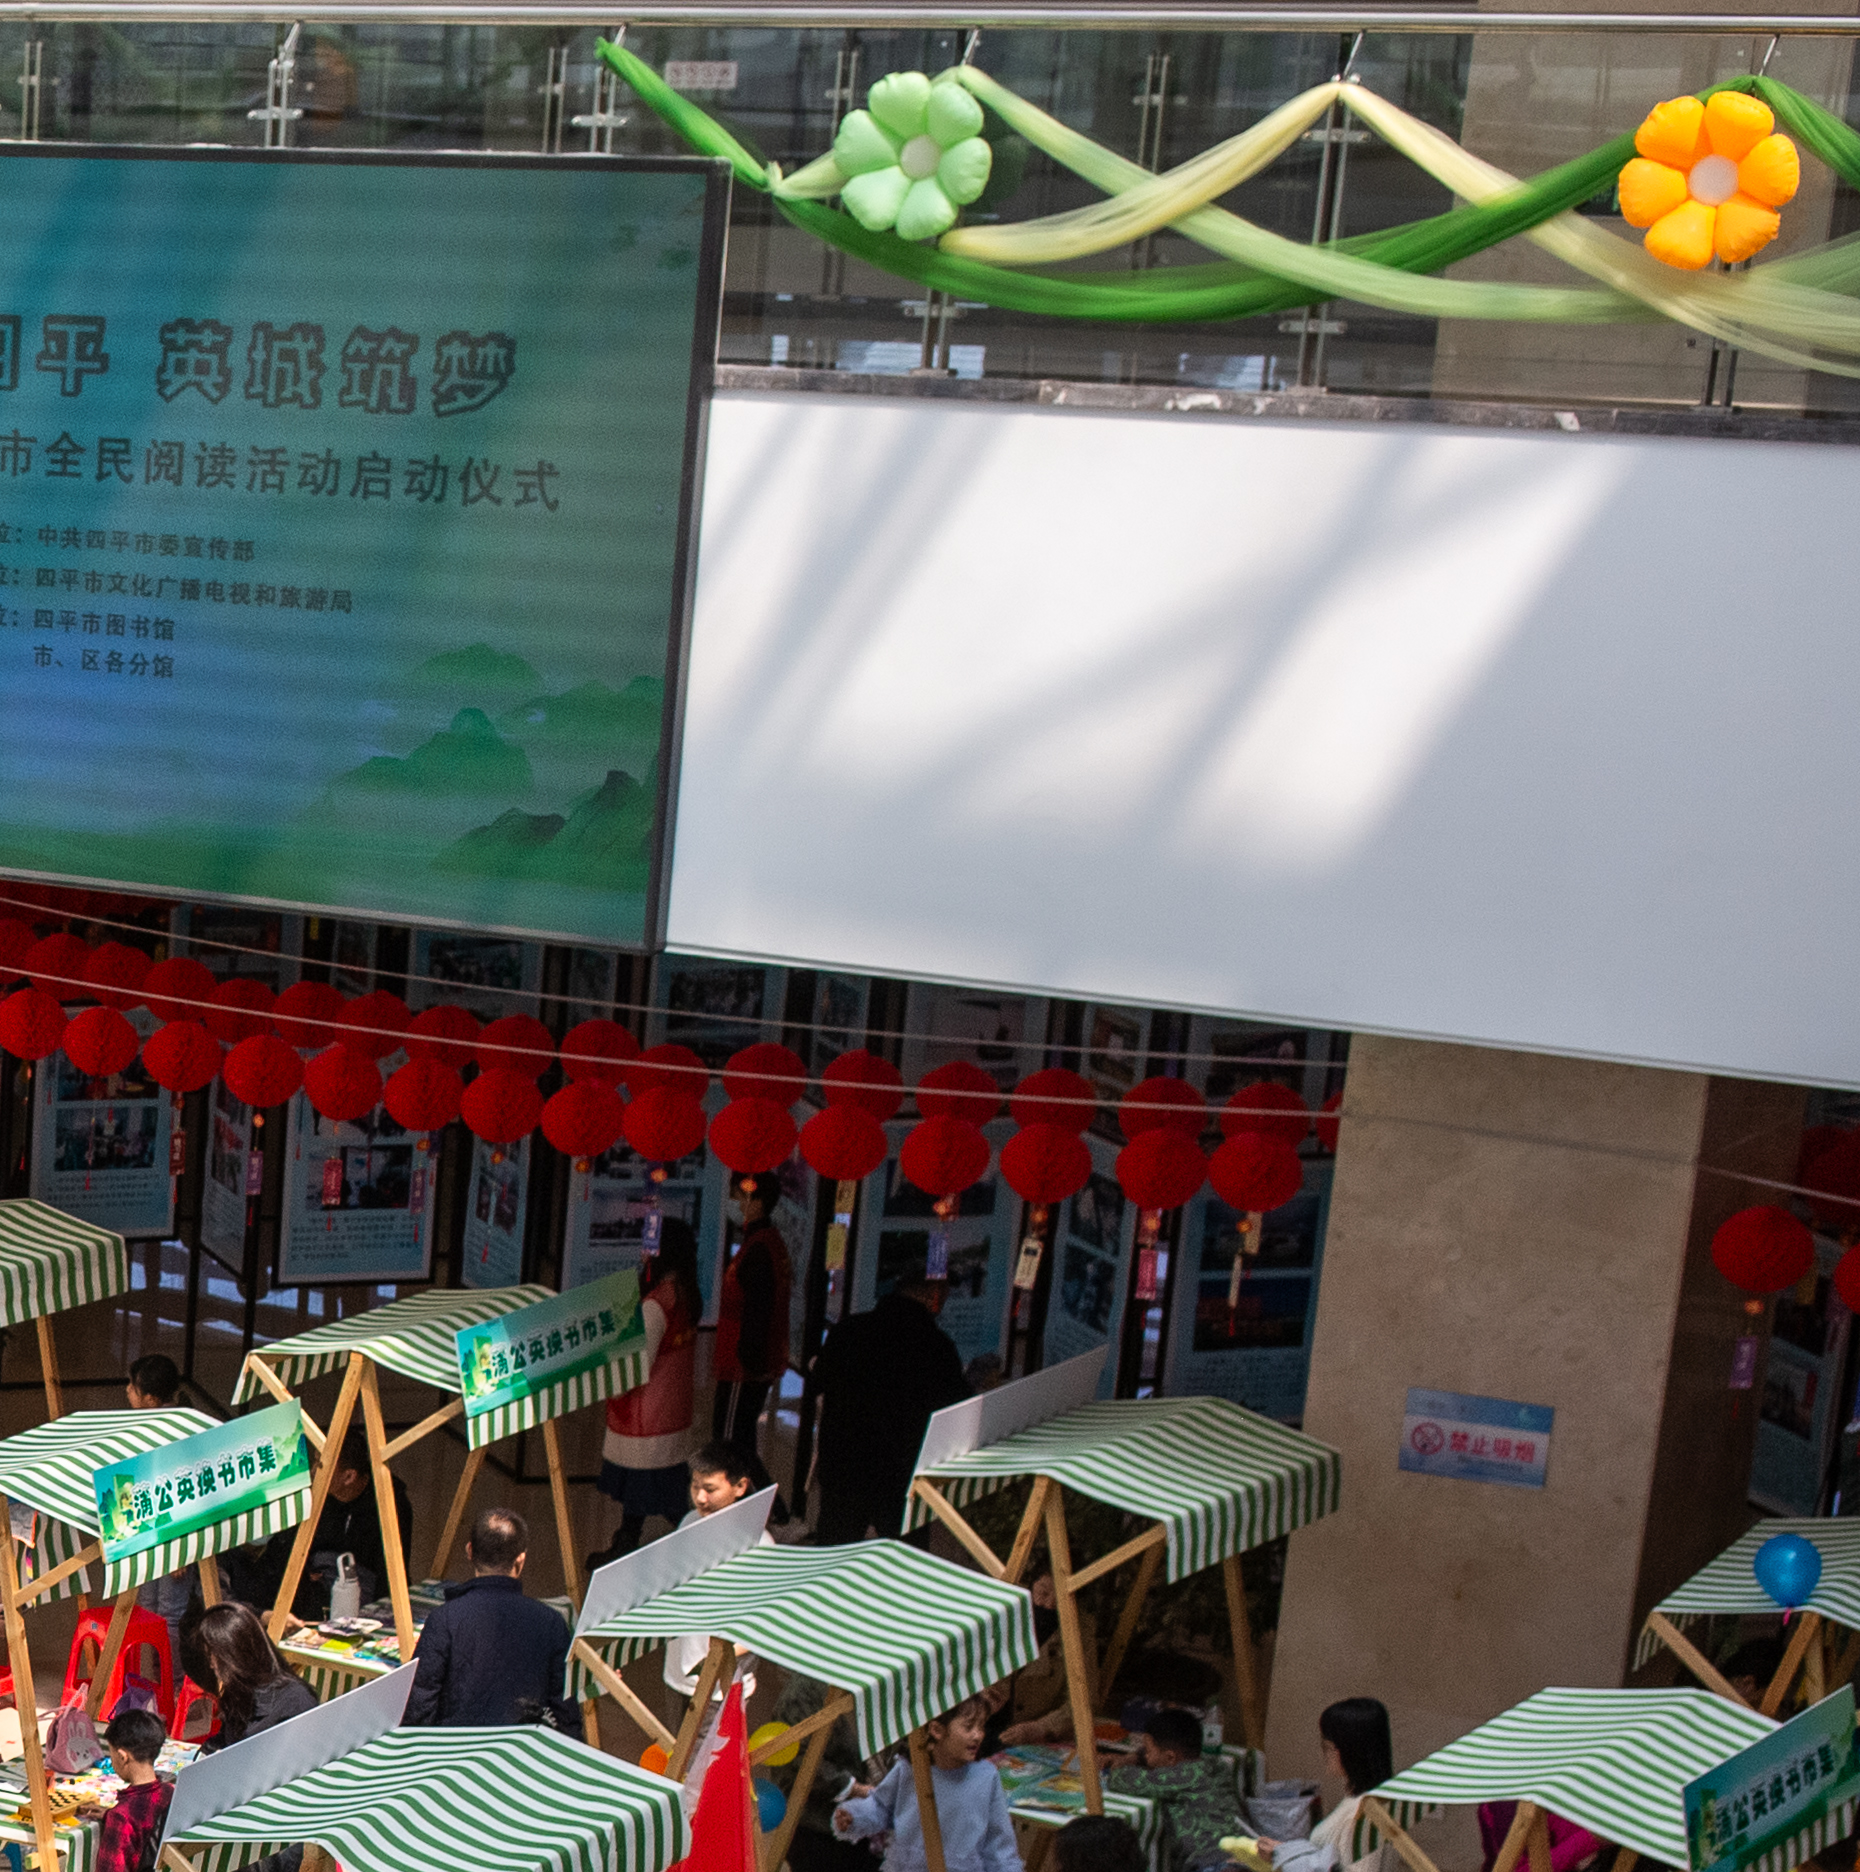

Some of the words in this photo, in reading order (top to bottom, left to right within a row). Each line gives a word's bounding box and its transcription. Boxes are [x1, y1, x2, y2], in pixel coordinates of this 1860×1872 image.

[155, 316, 519, 419] 英城筑梦
[132, 1437, 278, 1521] 蒲公英换书市集
